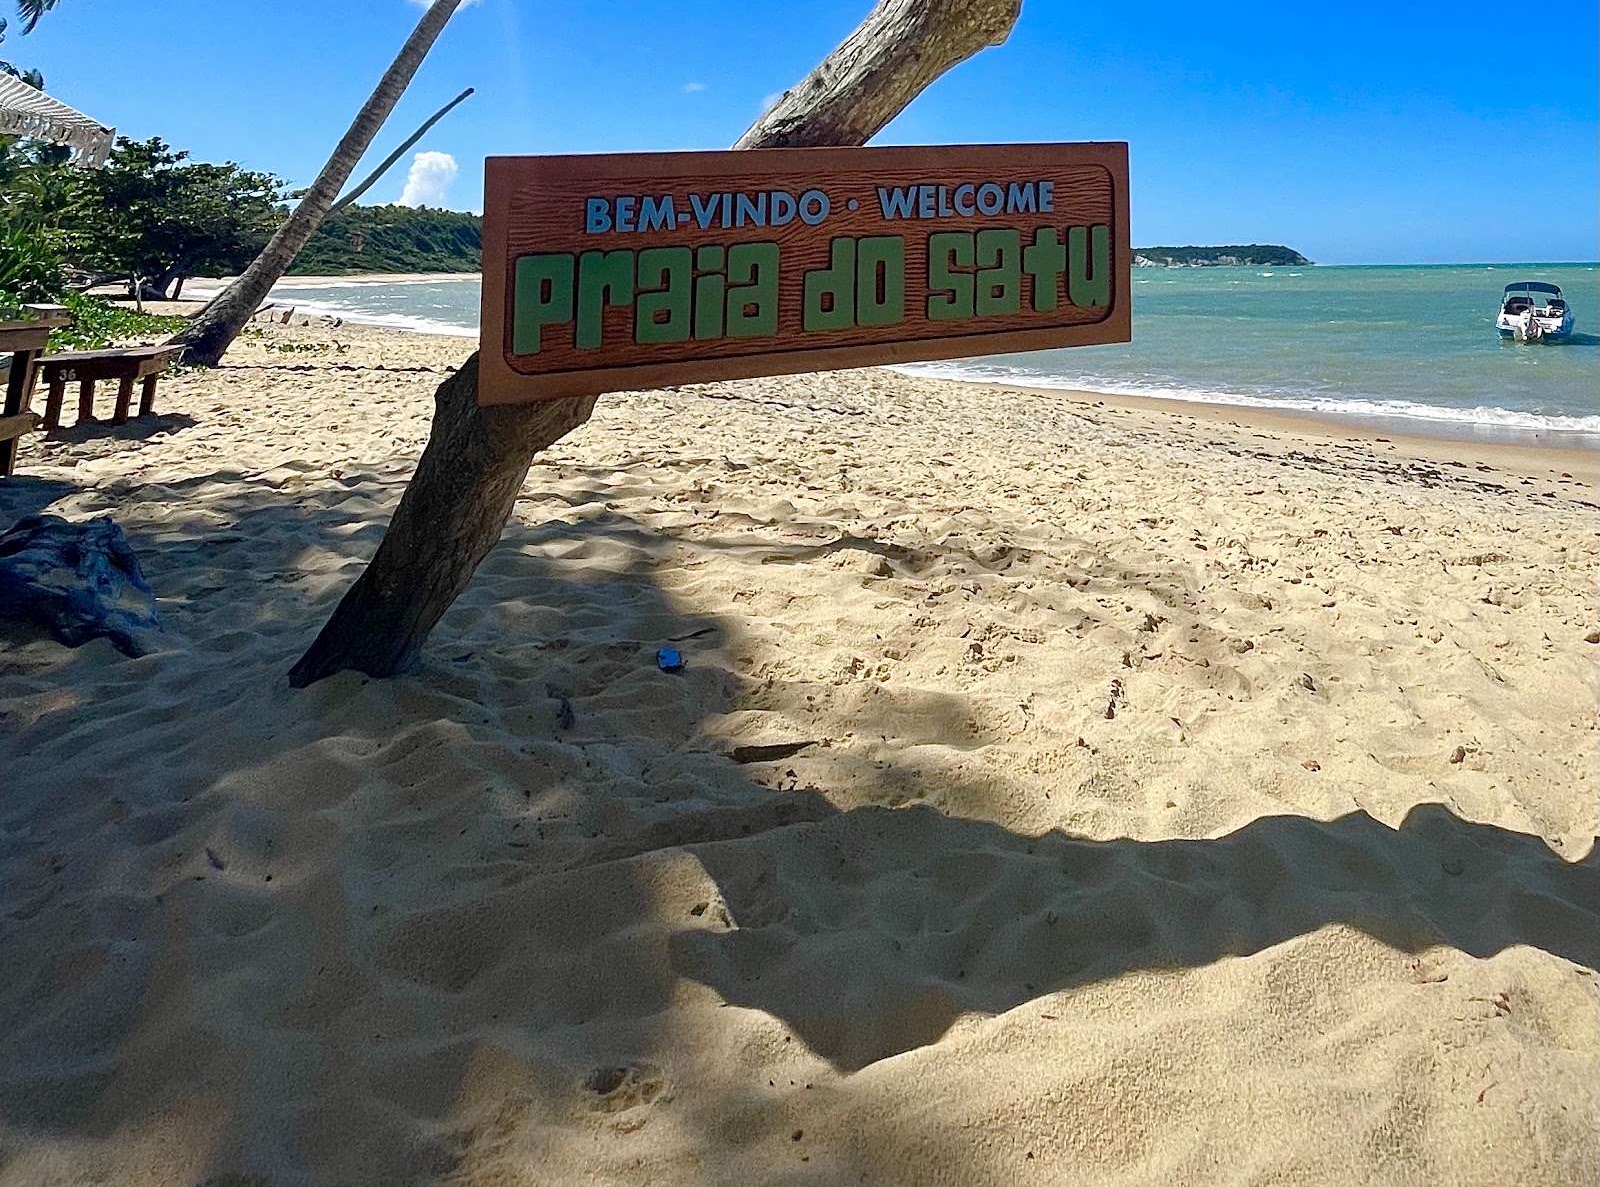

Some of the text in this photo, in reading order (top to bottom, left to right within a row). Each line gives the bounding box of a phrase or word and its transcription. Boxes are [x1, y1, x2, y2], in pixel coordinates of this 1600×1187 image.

[585, 180, 1055, 234] BEM-VINDO WELCOME
[803, 235, 905, 332] do
[927, 223, 1111, 321] satu
[58, 368, 77, 381] 36
